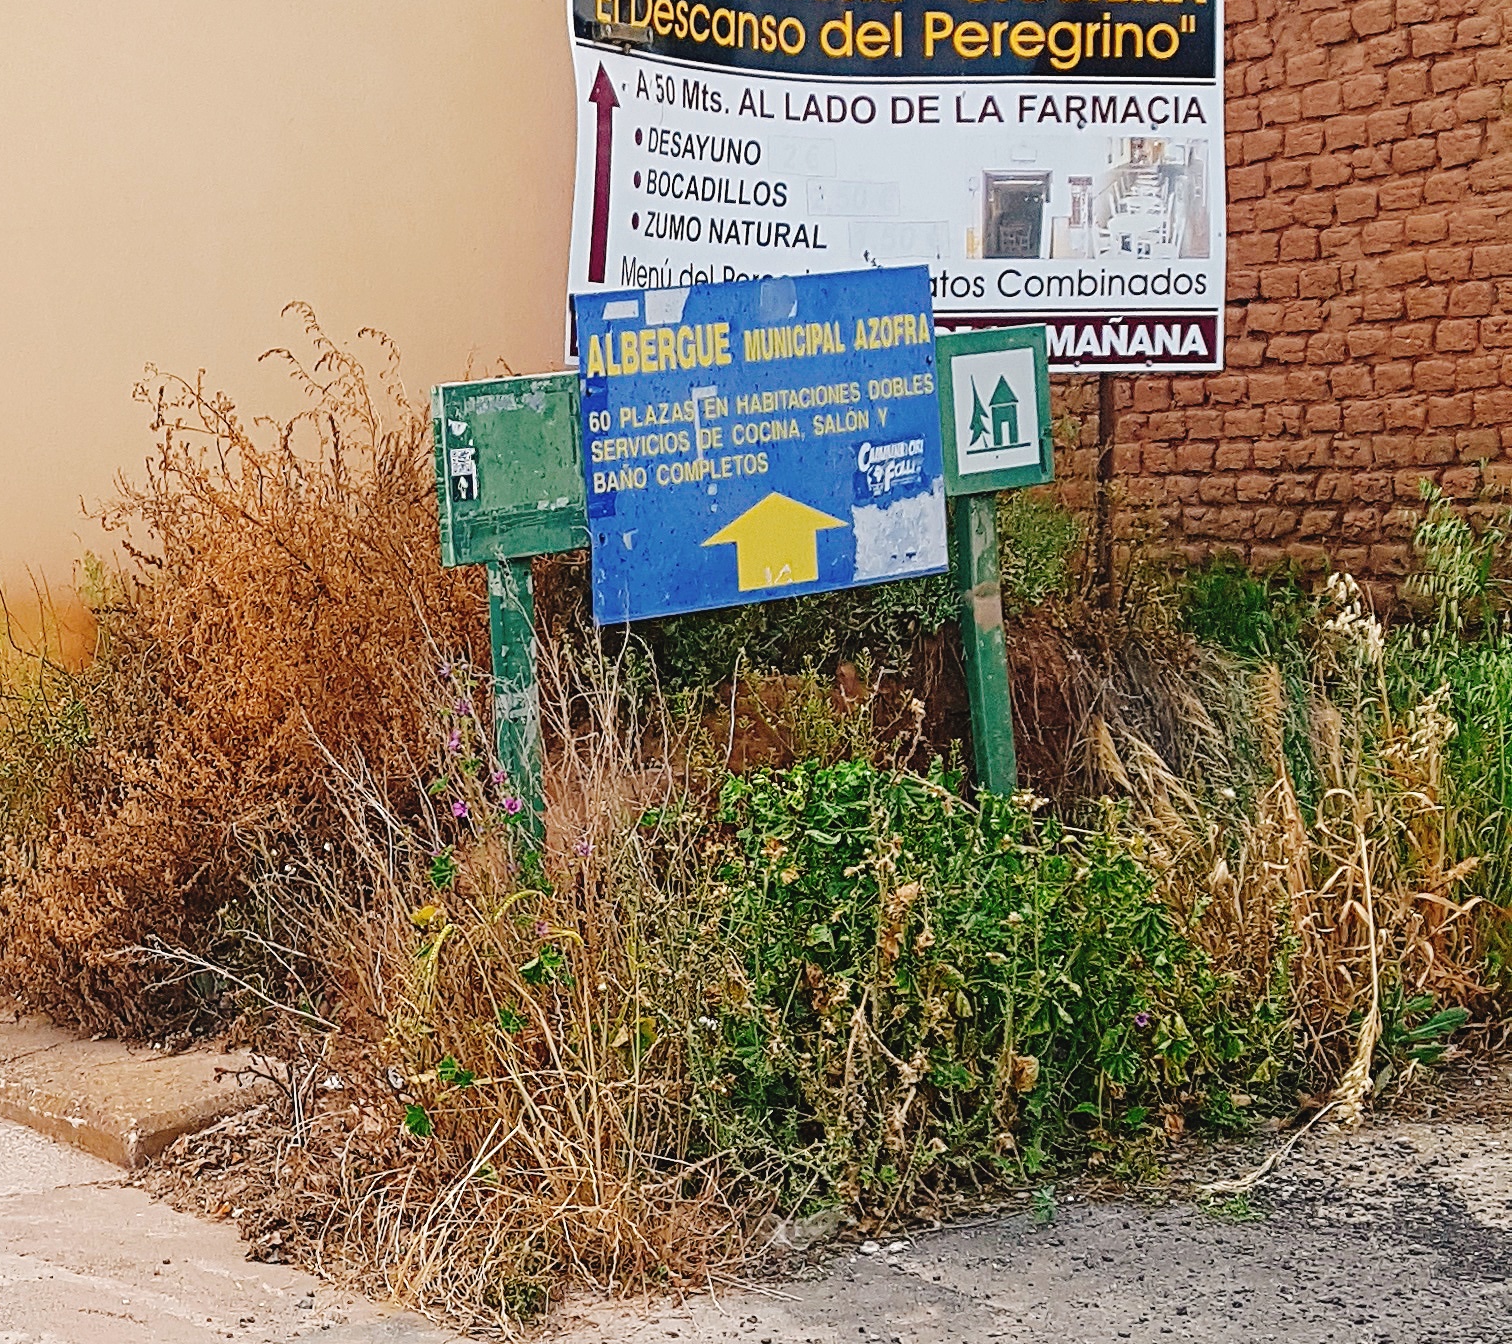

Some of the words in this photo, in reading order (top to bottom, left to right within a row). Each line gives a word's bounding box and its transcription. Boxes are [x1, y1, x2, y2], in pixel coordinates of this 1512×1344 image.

[820, 9, 903, 58] del
[923, 10, 1197, 71] Peregrino"
[636, 69, 650, 101] A
[654, 74, 676, 105] 50
[682, 78, 730, 115] Mts.
[738, 88, 775, 120] AL
[784, 92, 877, 124] LADO
[891, 95, 940, 125] DE
[955, 94, 1005, 125] LA
[1018, 94, 1208, 126] FARMACIA
[648, 127, 762, 166] DESAYUNO
[646, 169, 788, 208] BOCADILLOS
[644, 211, 702, 243] ZUMO
[708, 218, 828, 249] NATURAL
[621, 256, 672, 288] Menú
[930, 270, 985, 298] atos
[997, 267, 1207, 298] Combinados
[587, 322, 731, 378] ALBERGUE
[744, 320, 847, 363] MUNICIPAL
[853, 312, 931, 351] AZOFRA
[1047, 316, 1208, 357] MAÑANA
[589, 410, 611, 433] 60
[620, 400, 695, 428] PLAZAS
[704, 396, 729, 419] EN
[736, 381, 861, 415] HABITACIONES
[868, 373, 934, 401] DOBLES
[591, 430, 691, 463] SERVICIOS
[699, 427, 724, 450] DE
[813, 407, 869, 436] SALÓN
[878, 407, 888, 428] Y
[593, 464, 647, 494] BAÑO
[656, 452, 769, 487] COMPLETOS
